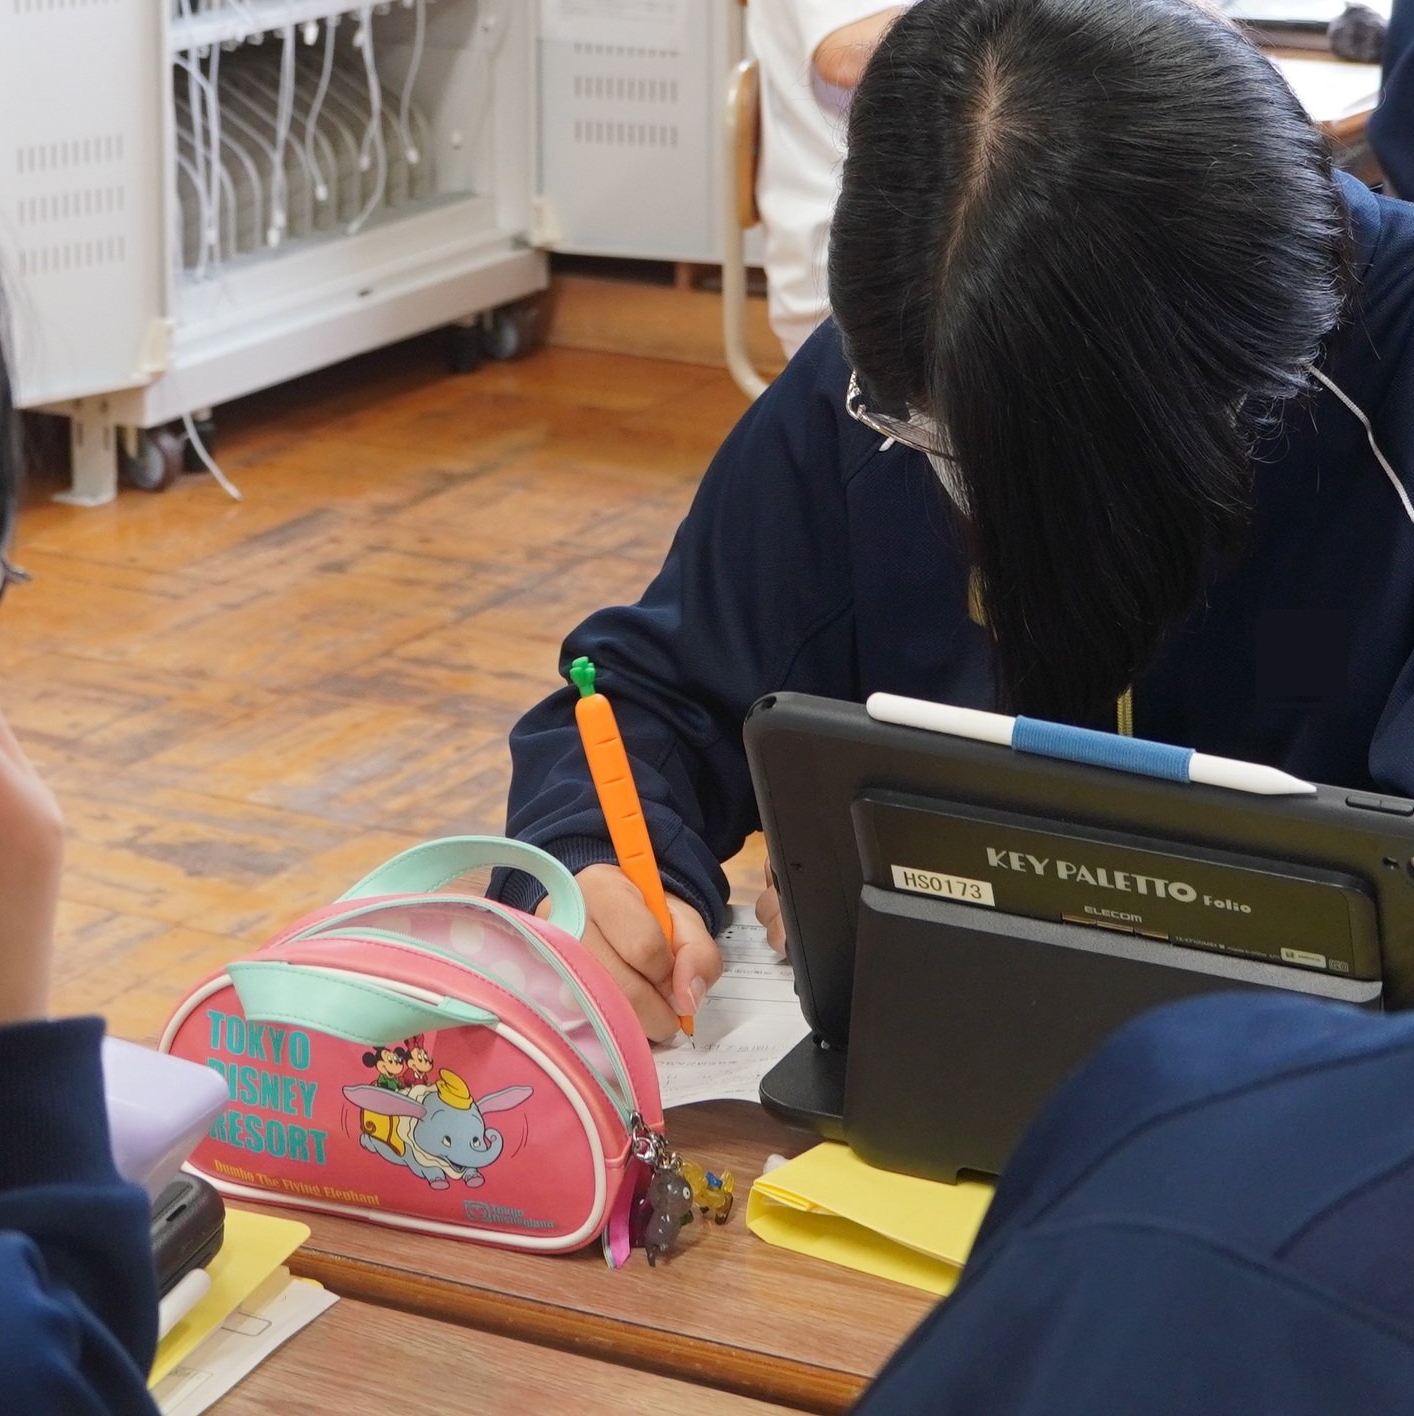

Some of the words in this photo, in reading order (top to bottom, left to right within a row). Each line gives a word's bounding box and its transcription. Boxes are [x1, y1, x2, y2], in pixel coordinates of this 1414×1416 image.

[903, 871, 982, 900] HS0173
[985, 846, 1050, 876] KEY
[1056, 860, 1197, 903] PALETTO
[1203, 895, 1252, 914] Folio
[1084, 905, 1143, 923] ELECOM
[207, 1009, 311, 1071] TOKYO
[213, 1159, 254, 1182] Dumbo
[256, 1173, 280, 1187] The
[281, 1178, 321, 1197] Flying
[323, 1186, 381, 1206] Elephant
